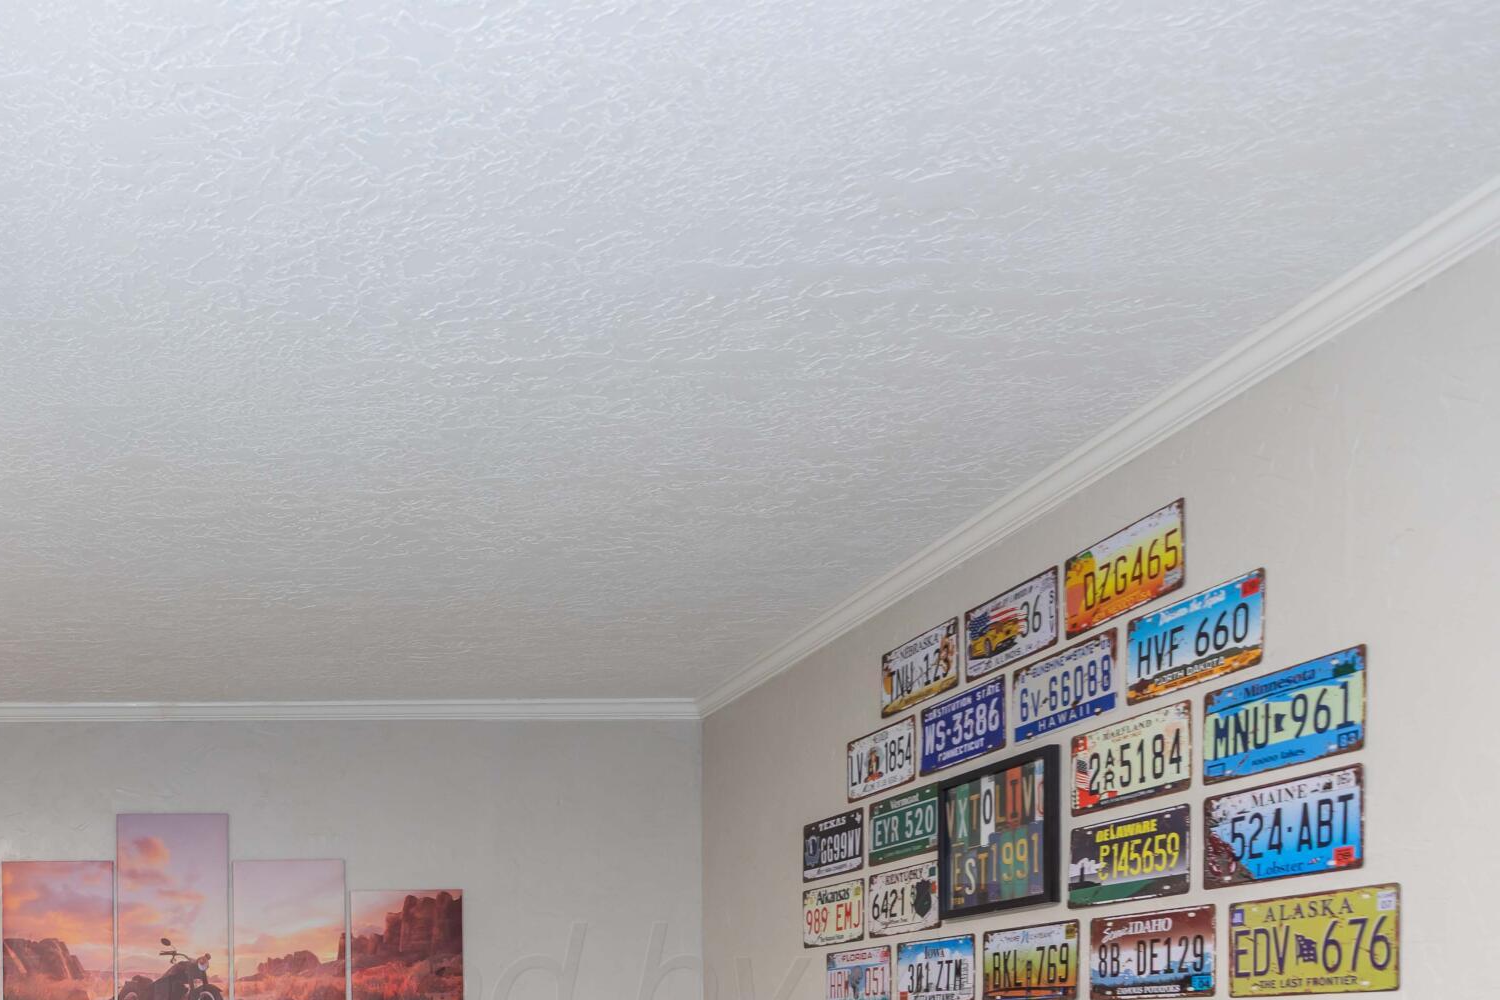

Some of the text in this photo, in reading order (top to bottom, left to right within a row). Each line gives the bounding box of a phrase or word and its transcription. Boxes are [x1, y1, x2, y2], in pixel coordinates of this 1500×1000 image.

[1083, 528, 1179, 611] DZG465
[1137, 625, 1184, 678] HVF
[1195, 603, 1250, 657] 660
[975, 683, 1001, 700] STATE
[1243, 668, 1316, 698] Minnesota
[1038, 704, 1091, 732] HAWAII
[1214, 681, 1356, 761] MNU 961
[851, 752, 864, 786] LV
[885, 732, 912, 774] 1854
[1250, 783, 1308, 808] MAINE
[819, 815, 846, 832] TEXAS
[875, 804, 934, 847] EYR 520
[1096, 818, 1157, 842] DELAWARE
[1256, 862, 1304, 877] Lobster
[816, 887, 851, 906] Arkansas
[872, 887, 906, 921] 6421
[1264, 897, 1355, 924] ALASKA
[805, 900, 861, 936] 989 EMJ
[1128, 917, 1173, 934] IDAHO
[841, 951, 873, 963] FLORIDA
[1100, 935, 1205, 978] 8B DE129
[1235, 915, 1391, 978] EDV 676
[993, 948, 1022, 989] BKL
[1036, 943, 1069, 986] 769
[864, 967, 885, 996] 051
[1259, 975, 1358, 989] THE LAST FRONTIER
